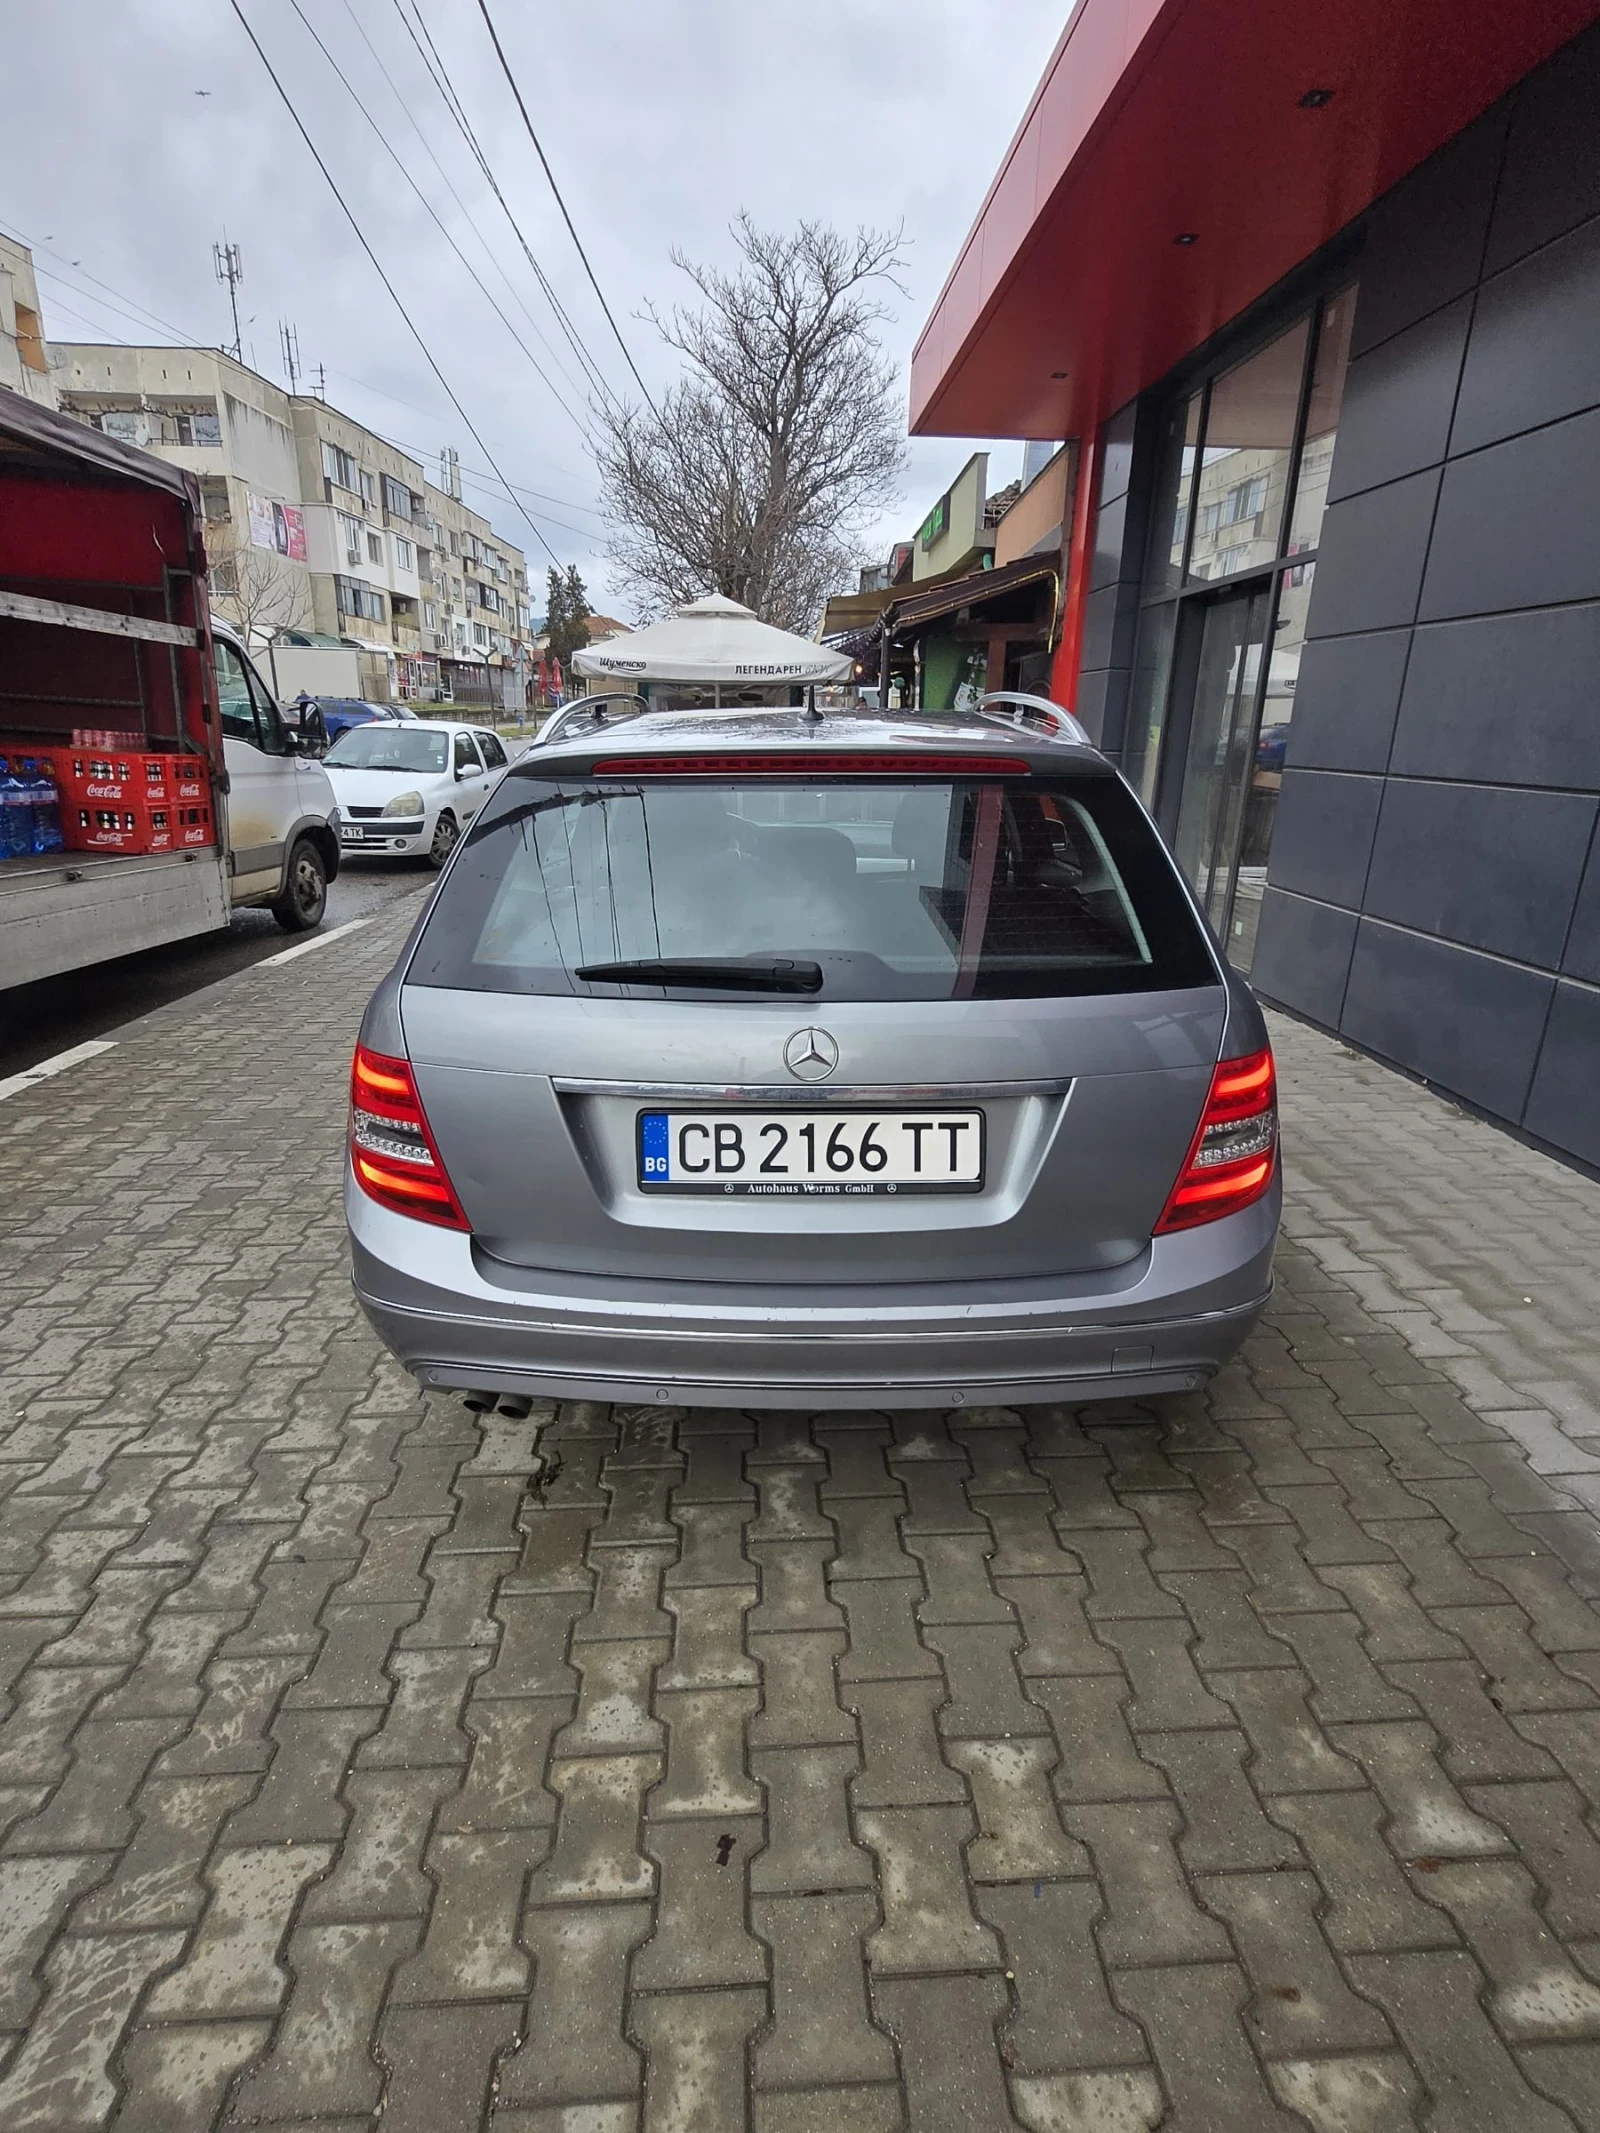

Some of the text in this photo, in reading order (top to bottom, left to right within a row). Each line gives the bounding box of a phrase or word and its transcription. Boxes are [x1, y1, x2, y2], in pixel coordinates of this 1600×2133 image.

[599, 657, 647, 671] Шуменско
[735, 665, 802, 675] ЛЕГЕНДАРЕН
[87, 783, 122, 798] Coca-Cola
[180, 784, 199, 797] Coca-Cola
[96, 831, 123, 843] Coca-Cola
[185, 829, 204, 842] Coca-Cola
[679, 1122, 969, 1173] CB 2166 TT
[645, 1157, 667, 1172] BG
[747, 1184, 799, 1193] Autohaus
[845, 1185, 874, 1193] GmbH
